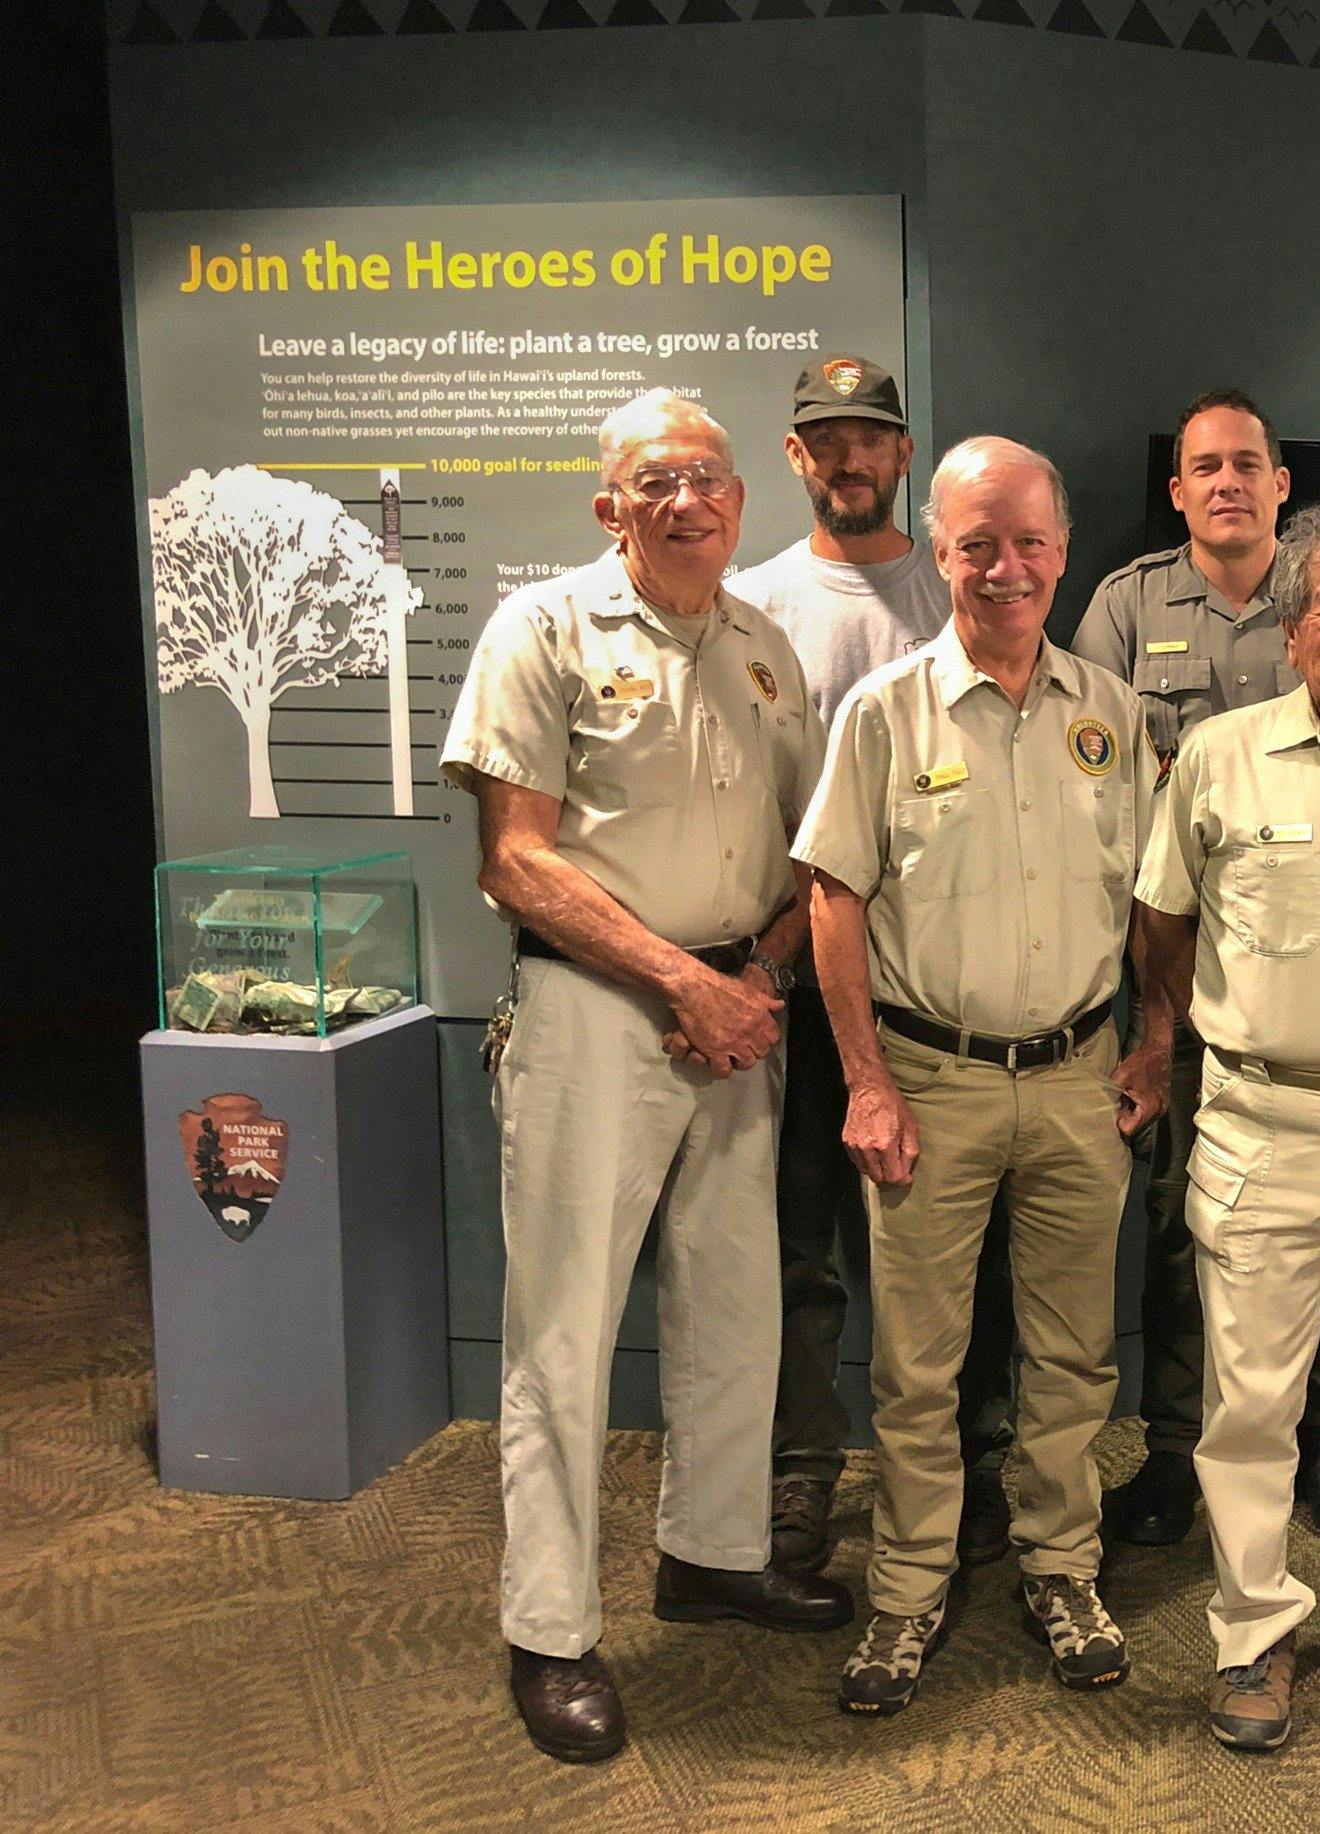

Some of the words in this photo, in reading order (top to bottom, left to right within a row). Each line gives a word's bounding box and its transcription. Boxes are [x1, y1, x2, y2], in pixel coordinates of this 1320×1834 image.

[180, 243, 289, 293] Join
[302, 240, 391, 290] the
[407, 238, 596, 290] Heroes
[611, 233, 666, 287] of
[683, 233, 832, 295] Hope
[259, 333, 325, 358] Leave
[331, 338, 346, 357] a
[349, 332, 427, 362] legacy
[433, 331, 456, 356] of
[460, 330, 506, 356] life:
[510, 330, 573, 358] plant
[577, 336, 592, 354] a
[597, 330, 652, 357] tree,
[658, 333, 721, 358] grow
[725, 334, 740, 352] a
[745, 326, 819, 352] forest
[261, 372, 283, 384] You
[285, 374, 303, 384] can
[308, 372, 333, 386] help
[336, 373, 379, 384] restore
[379, 372, 398, 383] the
[401, 371, 451, 386] diversity
[454, 370, 466, 382] of
[468, 370, 487, 382] life
[489, 370, 500, 381] in
[557, 369, 599, 385] upland
[602, 369, 645, 381] forests.
[297, 389, 332, 402] lehua,
[335, 390, 359, 402] koa,
[398, 389, 419, 400] and
[422, 389, 444, 402] pilo
[448, 391, 466, 401] are
[468, 388, 487, 400] the
[490, 389, 510, 403] key
[514, 388, 556, 403] species
[559, 388, 584, 400] that
[586, 387, 632, 401] provide
[635, 386, 648, 397] th
[262, 408, 278, 419] for
[281, 409, 313, 421] many
[316, 407, 348, 420] birds,
[351, 407, 393, 420] insects,
[396, 406, 418, 418] and
[420, 406, 452, 418] other
[455, 405, 494, 420] plants.
[498, 406, 511, 418] As
[514, 408, 521, 418] a
[523, 405, 567, 420] healthy
[570, 404, 618, 417] underst
[263, 426, 283, 437] out
[285, 425, 348, 436] non-native
[351, 427, 393, 439] grasses
[396, 425, 413, 438] yet
[416, 426, 477, 438] encourage
[480, 424, 499, 436] the
[502, 424, 553, 438] recovery
[556, 423, 568, 435] of
[571, 422, 600, 435] othe
[430, 459, 481, 474] 10,000
[484, 458, 517, 476] goal
[520, 458, 541, 472] for
[431, 497, 464, 508] 9,000
[433, 532, 466, 543] 8,000
[434, 568, 467, 579] 7,000
[497, 563, 524, 575] Your
[527, 563, 550, 576] $10
[497, 580, 518, 593] the
[435, 603, 469, 614] 6,000
[437, 638, 470, 651] 5,000
[438, 674, 467, 686] 4,00
[444, 813, 451, 823] 0
[222, 1124, 283, 1136] NATIONAL
[238, 1136, 269, 1147] PARK
[230, 1147, 279, 1158] SERVICE
